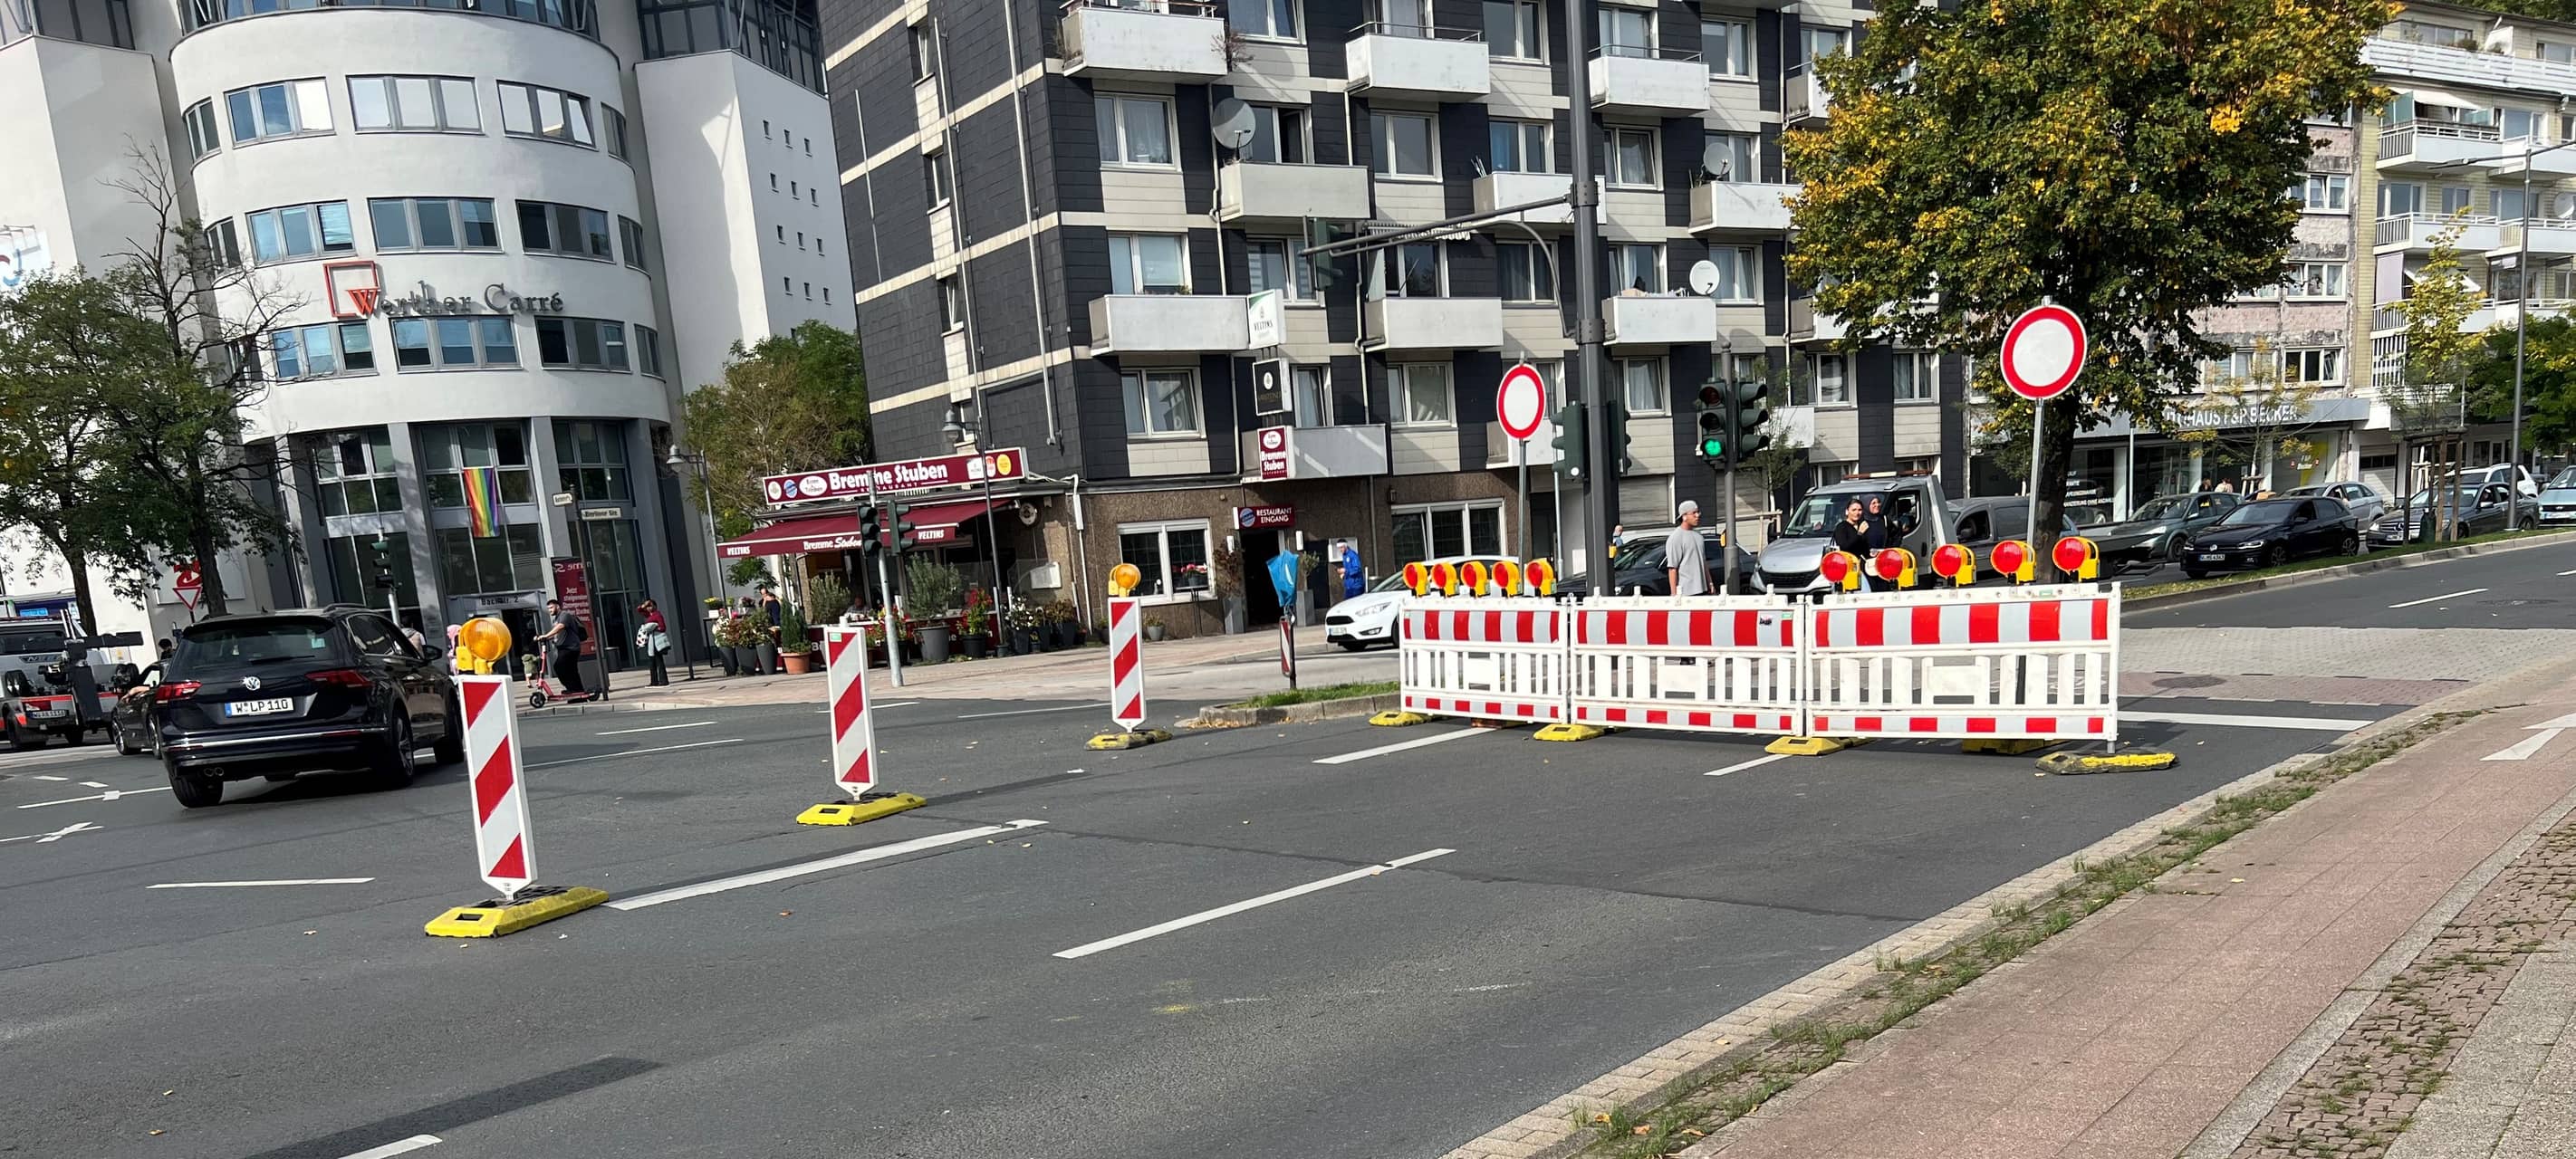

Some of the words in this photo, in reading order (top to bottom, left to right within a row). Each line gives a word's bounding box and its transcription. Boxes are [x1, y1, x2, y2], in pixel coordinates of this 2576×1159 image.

[485, 283, 563, 312] Carré
[2249, 405, 2298, 423] BECKER
[1264, 461, 1284, 471] Stuben
[828, 469, 893, 490] Bremme
[894, 462, 948, 483] Stuben
[1256, 508, 1292, 516] RESTAURANT
[1260, 515, 1289, 523] EINGANG
[918, 530, 944, 540] VELTINS
[803, 540, 834, 550] Bremme
[727, 546, 750, 555] VELTINS
[268, 699, 288, 710] 110
